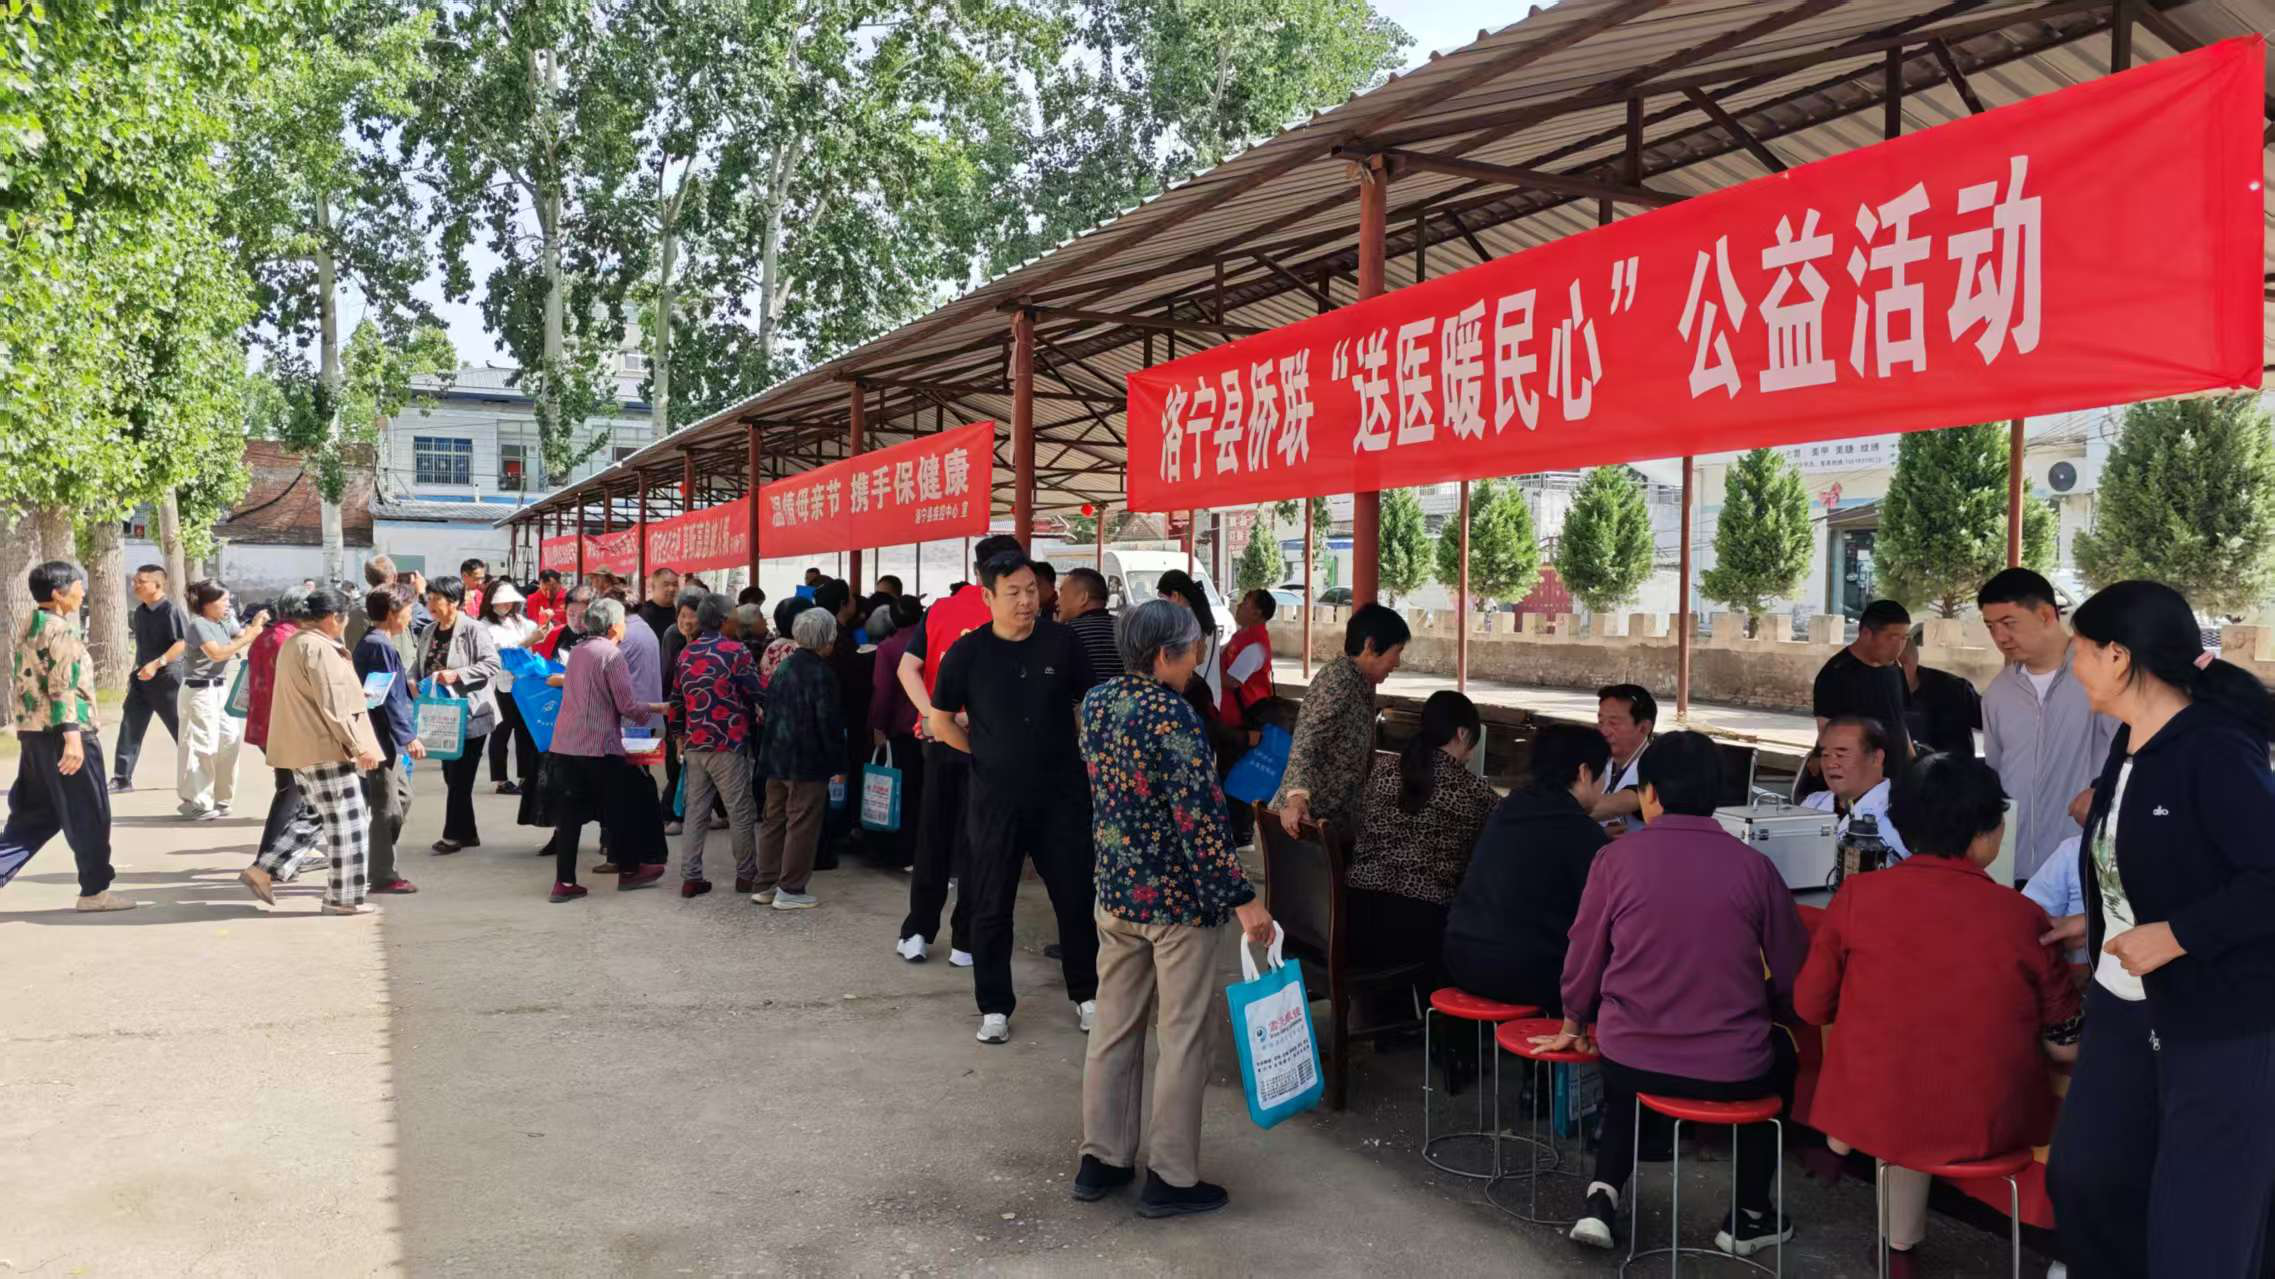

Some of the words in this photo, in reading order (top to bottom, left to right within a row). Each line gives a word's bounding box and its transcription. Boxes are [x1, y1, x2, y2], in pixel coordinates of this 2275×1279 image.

[1160, 348, 1314, 484] 洛宁县侨联
[1331, 257, 1639, 456] “送医暖民心”
[1677, 156, 2042, 400] 公益活动
[850, 447, 970, 513] 携手保健康
